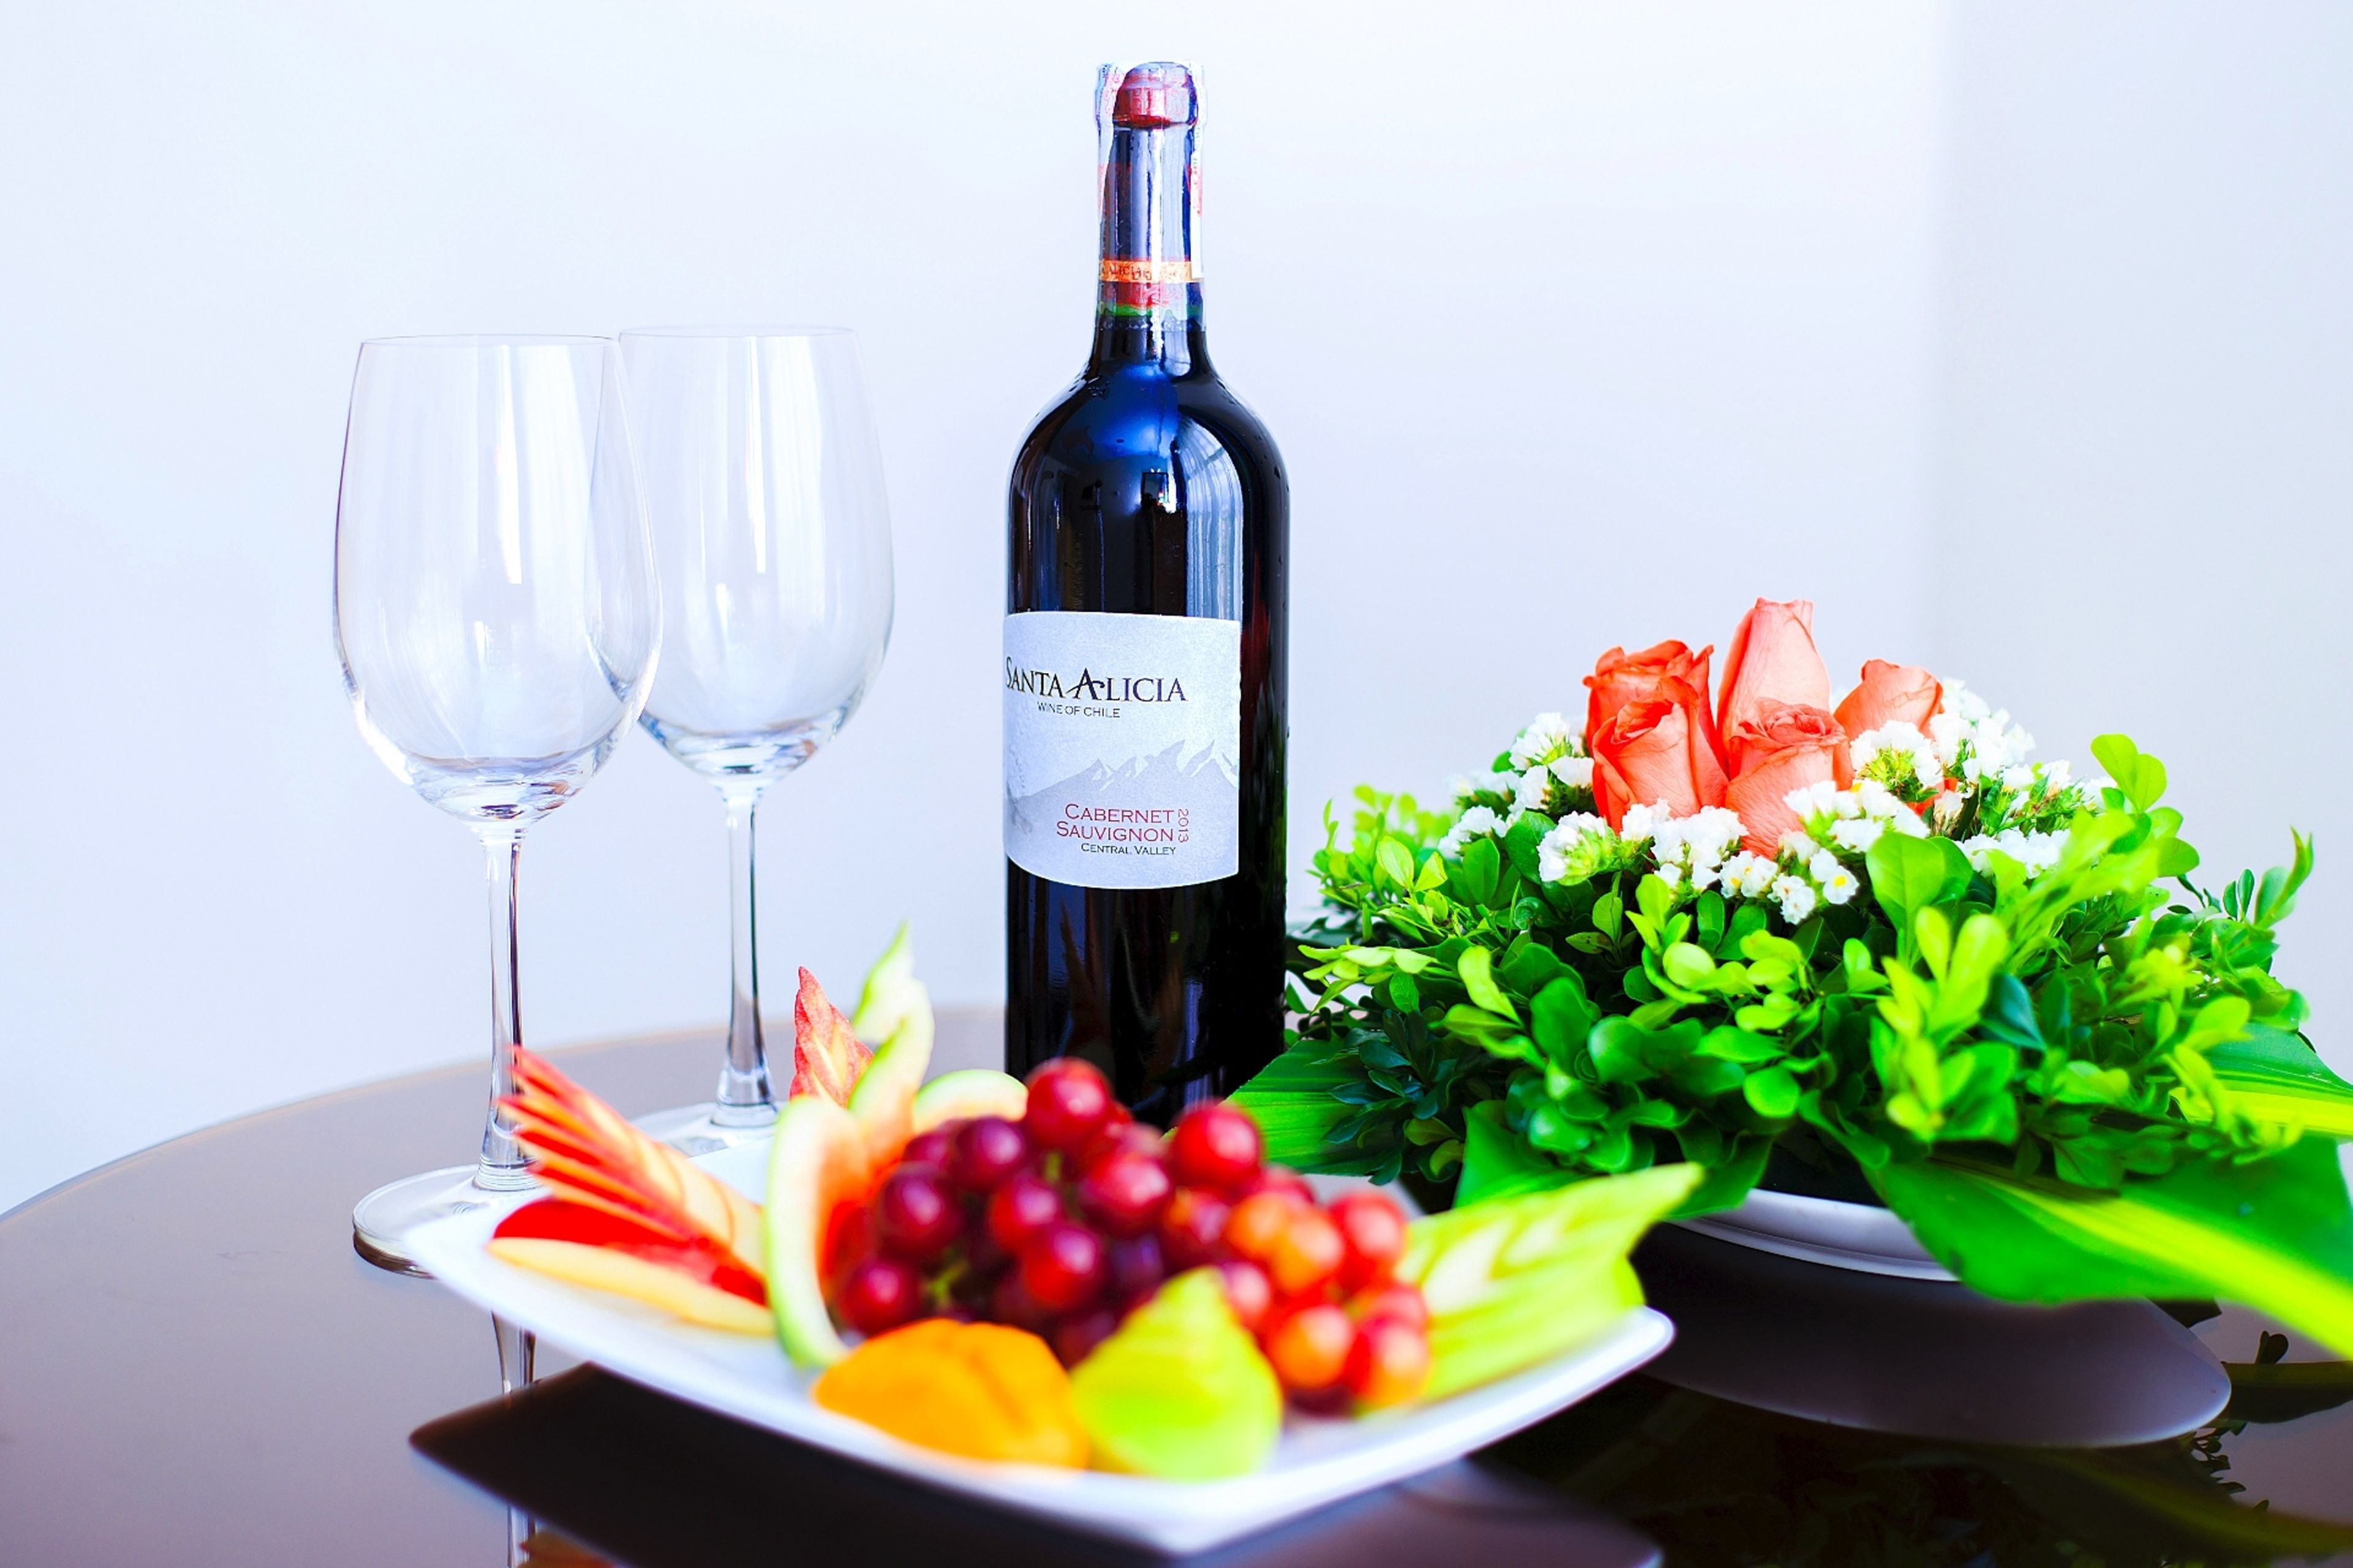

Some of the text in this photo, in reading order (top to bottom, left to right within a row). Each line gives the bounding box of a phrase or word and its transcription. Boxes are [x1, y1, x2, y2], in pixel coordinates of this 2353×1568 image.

[1006, 656, 1188, 702] SANTA ALICIA
[1037, 702, 1120, 718] WINE OF CHILE
[1065, 803, 1174, 823] CABERNET
[1056, 821, 1173, 841] SAUVIGNON
[1178, 809, 1189, 843] 2013
[1081, 843, 1176, 855] CENTRAL VALLEY
